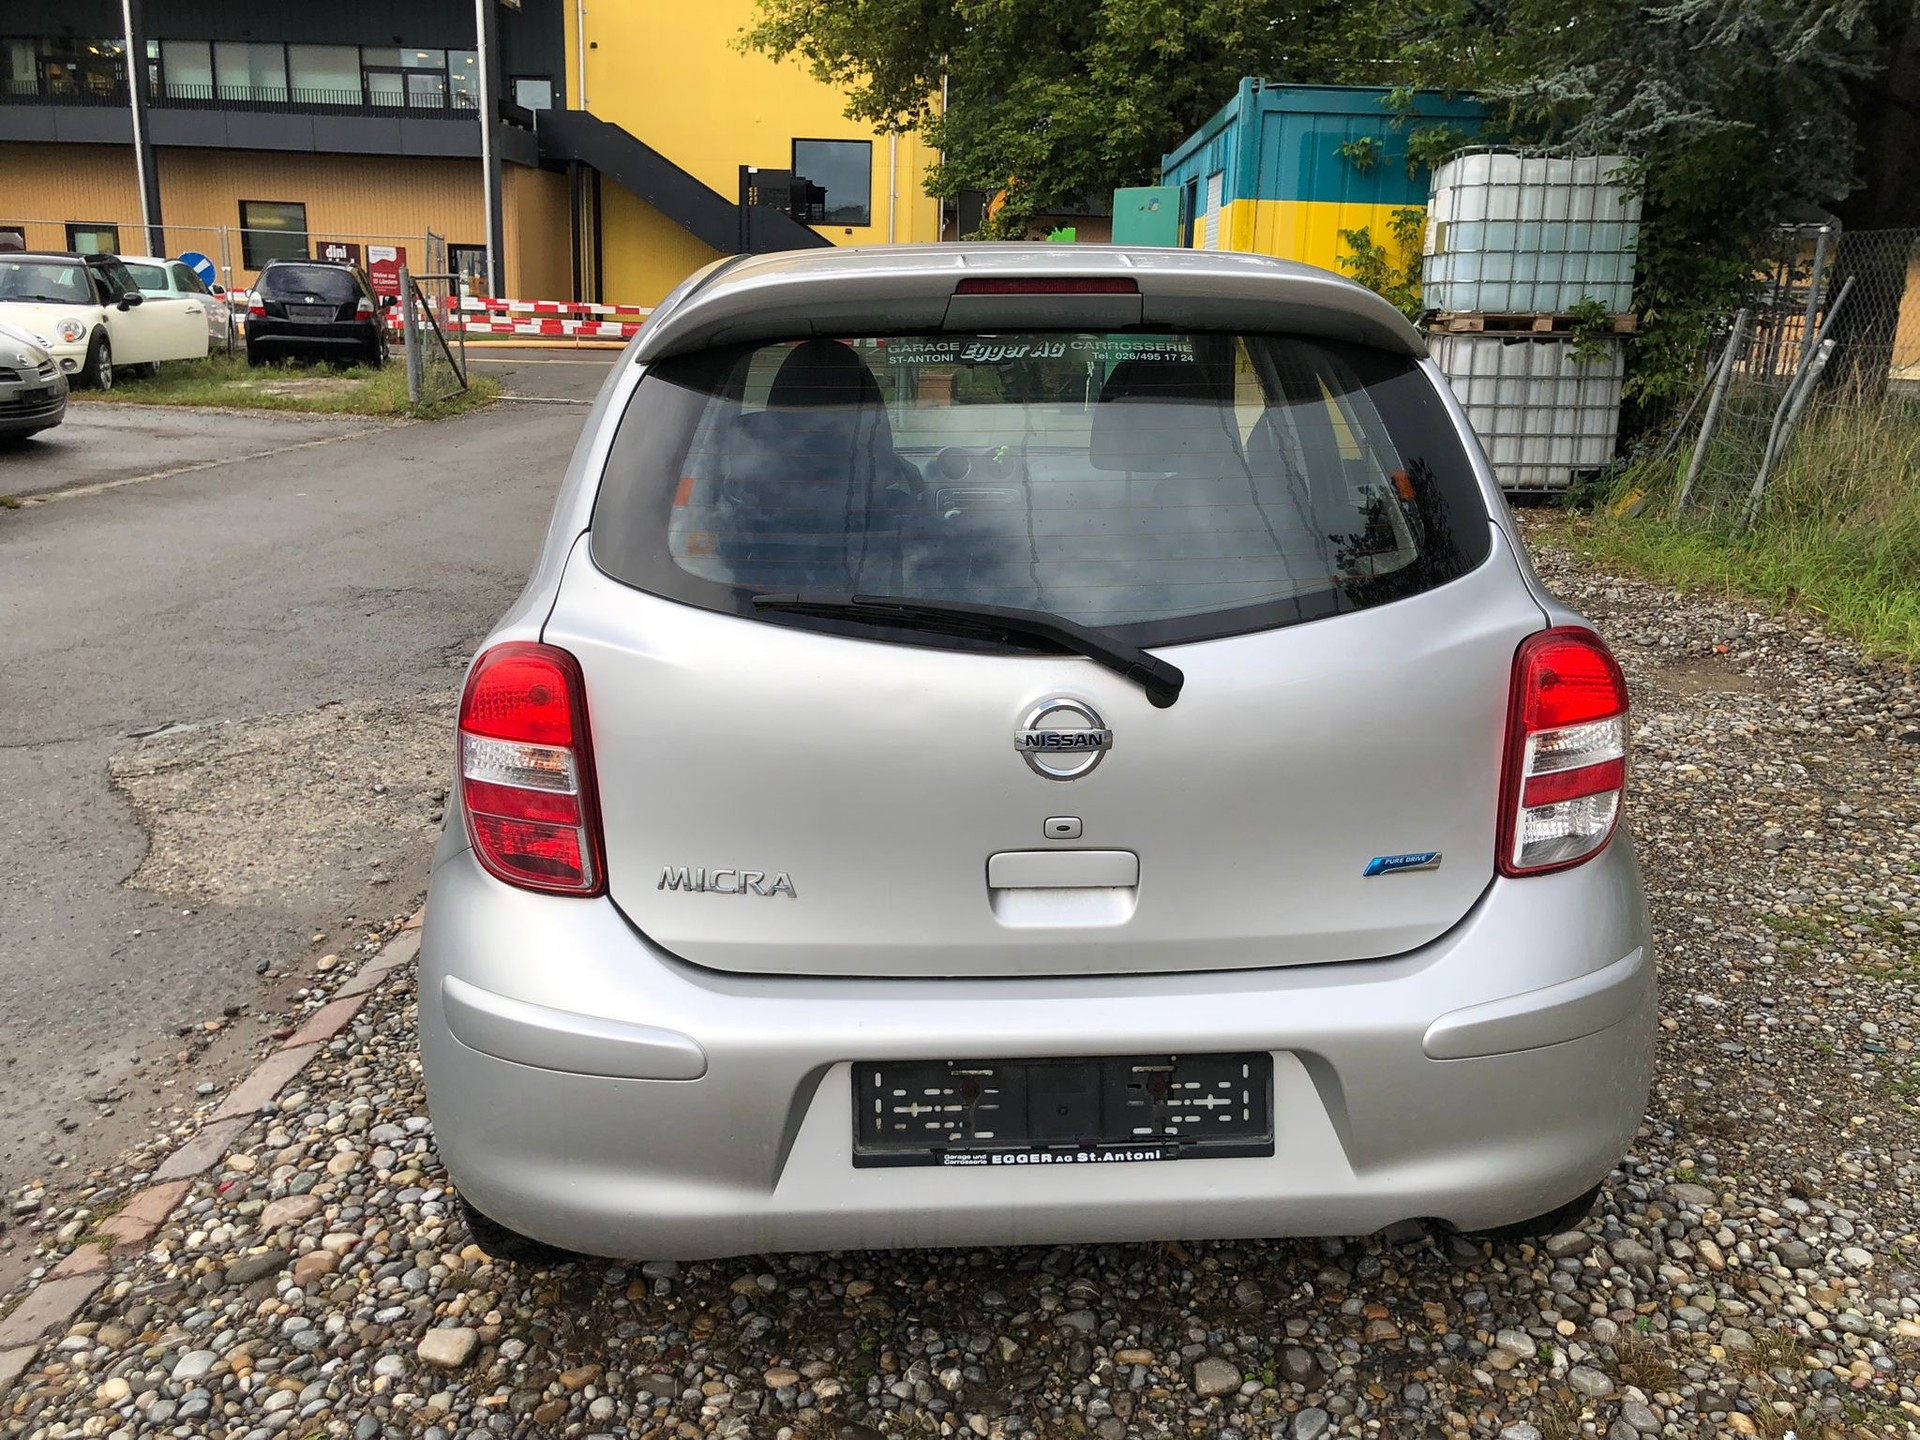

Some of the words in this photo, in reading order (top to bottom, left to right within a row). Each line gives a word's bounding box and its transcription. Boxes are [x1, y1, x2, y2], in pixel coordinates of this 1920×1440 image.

[888, 342, 961, 353] GARAGE
[960, 342, 1030, 361] Egger
[1030, 341, 1066, 358] AG
[1070, 341, 1193, 353] CARROSSERIE
[889, 354, 954, 364] ST-ANTONI
[1092, 352, 1112, 360] Tel.
[1115, 352, 1161, 360] 026/495
[1164, 353, 1177, 361] 17
[1180, 354, 1194, 362] 24
[1025, 733, 1103, 747] NISSAN
[1385, 857, 1404, 865] PURE
[1405, 855, 1427, 863] DRIVE
[657, 865, 797, 898] MICRA
[992, 1153, 1052, 1164] EGGER
[1056, 1155, 1073, 1163] AG
